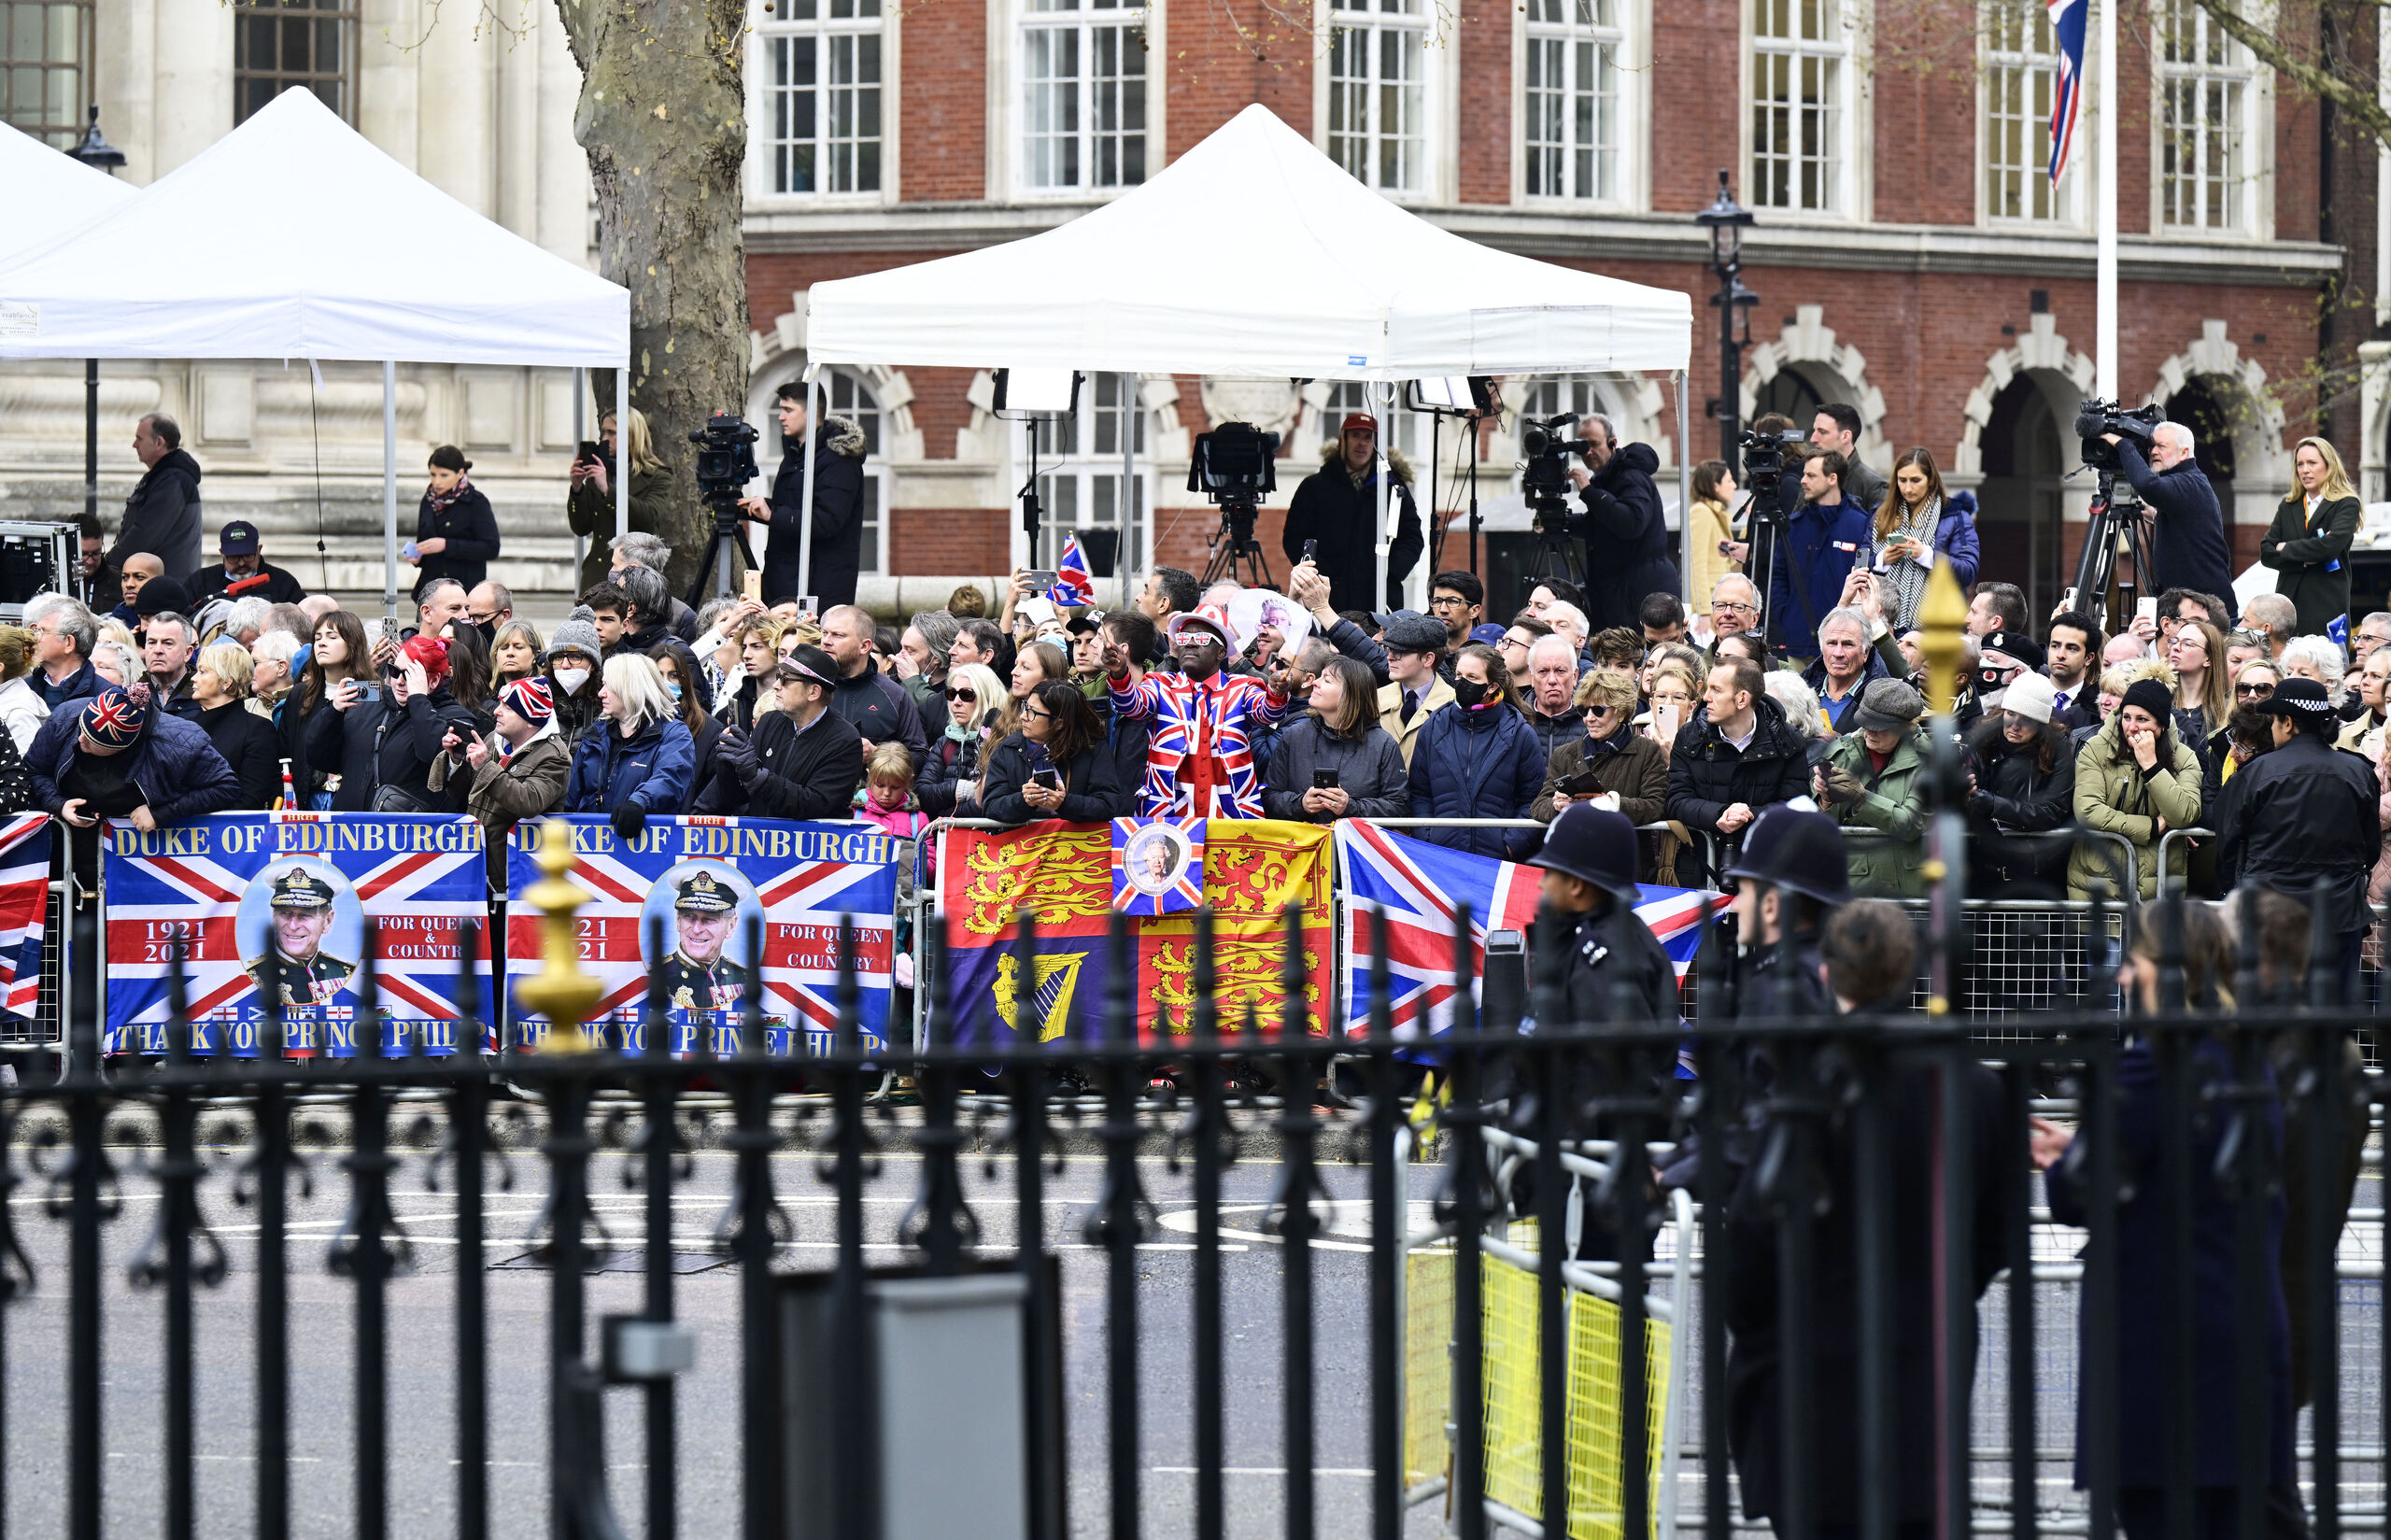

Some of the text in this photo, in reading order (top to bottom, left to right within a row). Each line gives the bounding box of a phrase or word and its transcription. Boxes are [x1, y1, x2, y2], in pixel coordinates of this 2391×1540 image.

[694, 816, 721, 825] HRH
[114, 823, 482, 856] DUKE OF EDINBURGH
[518, 825, 892, 864] DKE OF EDINBURGH
[145, 921, 206, 940] 1921
[378, 917, 416, 930] FOR
[425, 932, 436, 943] &
[779, 925, 817, 940] FOR
[144, 941, 205, 962] 2021
[388, 944, 463, 958] COUNTR
[825, 942, 837, 954] &
[787, 953, 874, 970] COUNRY
[116, 1023, 212, 1051] THAK
[280, 1021, 383, 1048] PRINC
[391, 1021, 487, 1048] PHILP
[517, 1021, 611, 1050] THNK
[617, 1024, 672, 1051] YO
[680, 1025, 777, 1057] PRINE
